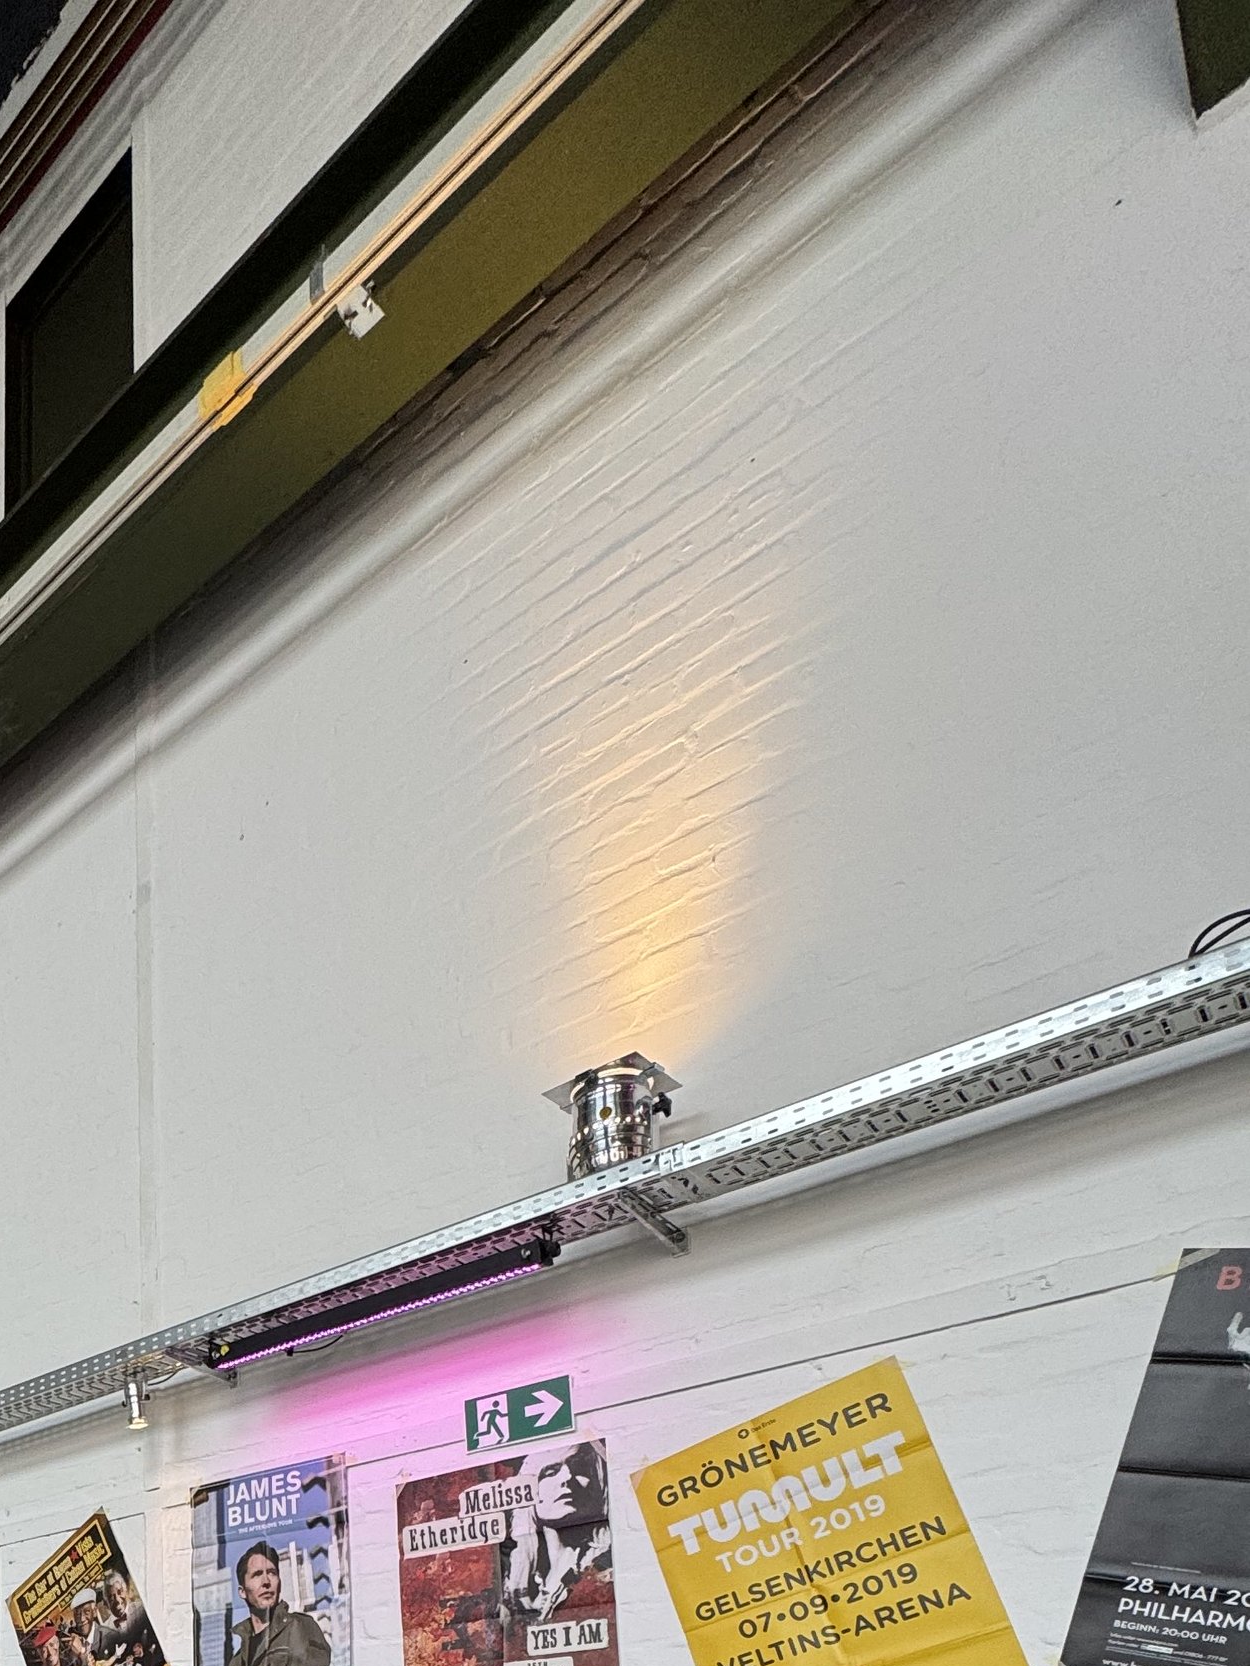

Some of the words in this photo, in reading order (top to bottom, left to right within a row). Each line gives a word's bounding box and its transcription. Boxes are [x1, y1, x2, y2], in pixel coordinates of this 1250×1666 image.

[656, 1392, 893, 1507] GRÖNEMEYER
[227, 1470, 302, 1506] JAMES
[464, 1482, 535, 1515] Melissa
[667, 1430, 906, 1556] TUMULT
[227, 1493, 301, 1527] BLUNT
[237, 1526, 249, 1534] THE
[278, 1518, 293, 1527] TOUR
[408, 1516, 500, 1552] Etheridge
[715, 1527, 803, 1573] TOUR
[810, 1494, 886, 1540] 2019
[695, 1515, 947, 1622] GELSENKIRCHEN
[22, 1590, 36, 1606] The
[1123, 1575, 1160, 1595] 28.
[1167, 1582, 1218, 1603] MAI
[1117, 1597, 1250, 1632] PHILHARM
[530, 1629, 558, 1651] YES
[562, 1626, 572, 1647] I
[577, 1622, 603, 1646] AM
[1113, 1619, 1159, 1634] BEGINN:
[1201, 1633, 1228, 1646] UHR
